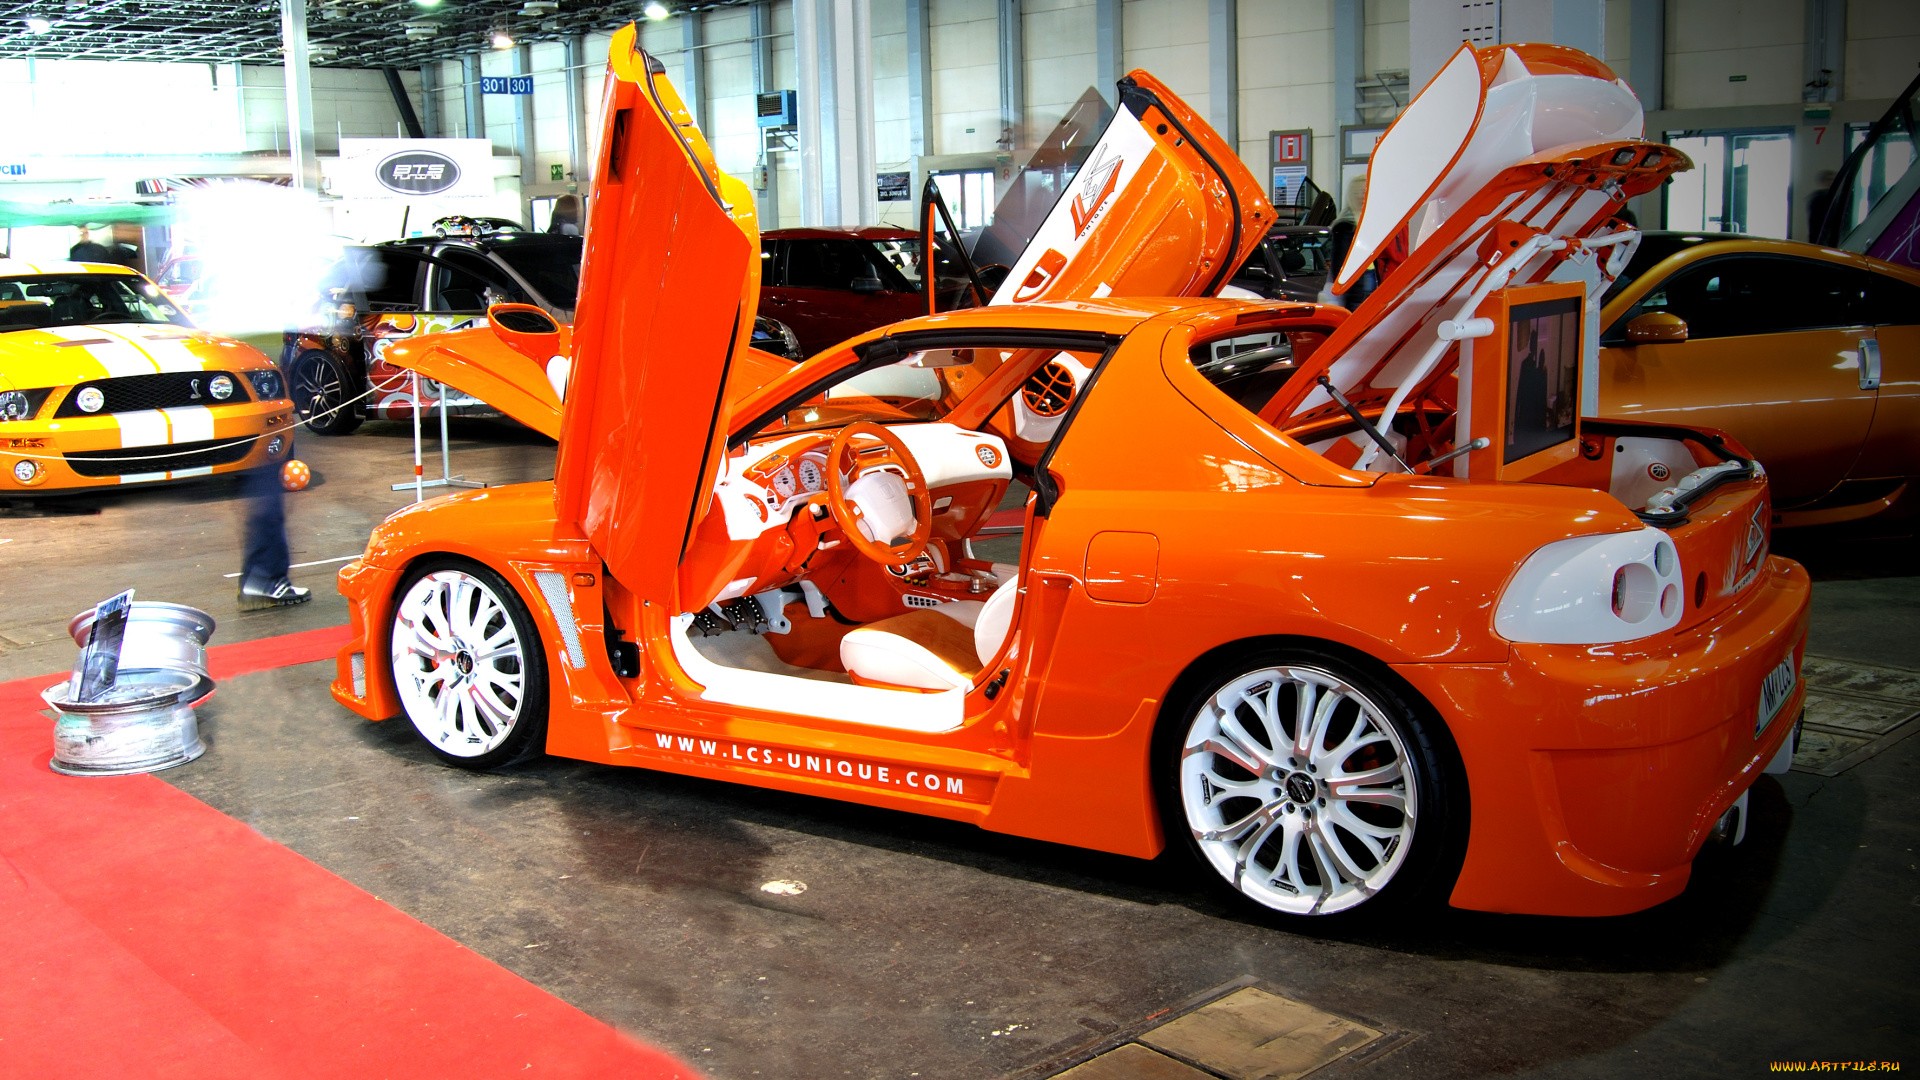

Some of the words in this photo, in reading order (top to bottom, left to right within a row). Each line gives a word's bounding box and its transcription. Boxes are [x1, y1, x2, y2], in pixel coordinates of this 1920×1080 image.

[482, 78, 505, 92] 301
[511, 79, 531, 93] 301
[1813, 126, 1827, 145] 7
[392, 163, 446, 175] BTS
[1080, 200, 1109, 238] UNIQUE
[655, 732, 965, 795] WWW.LCS-UNIQUE.COM
